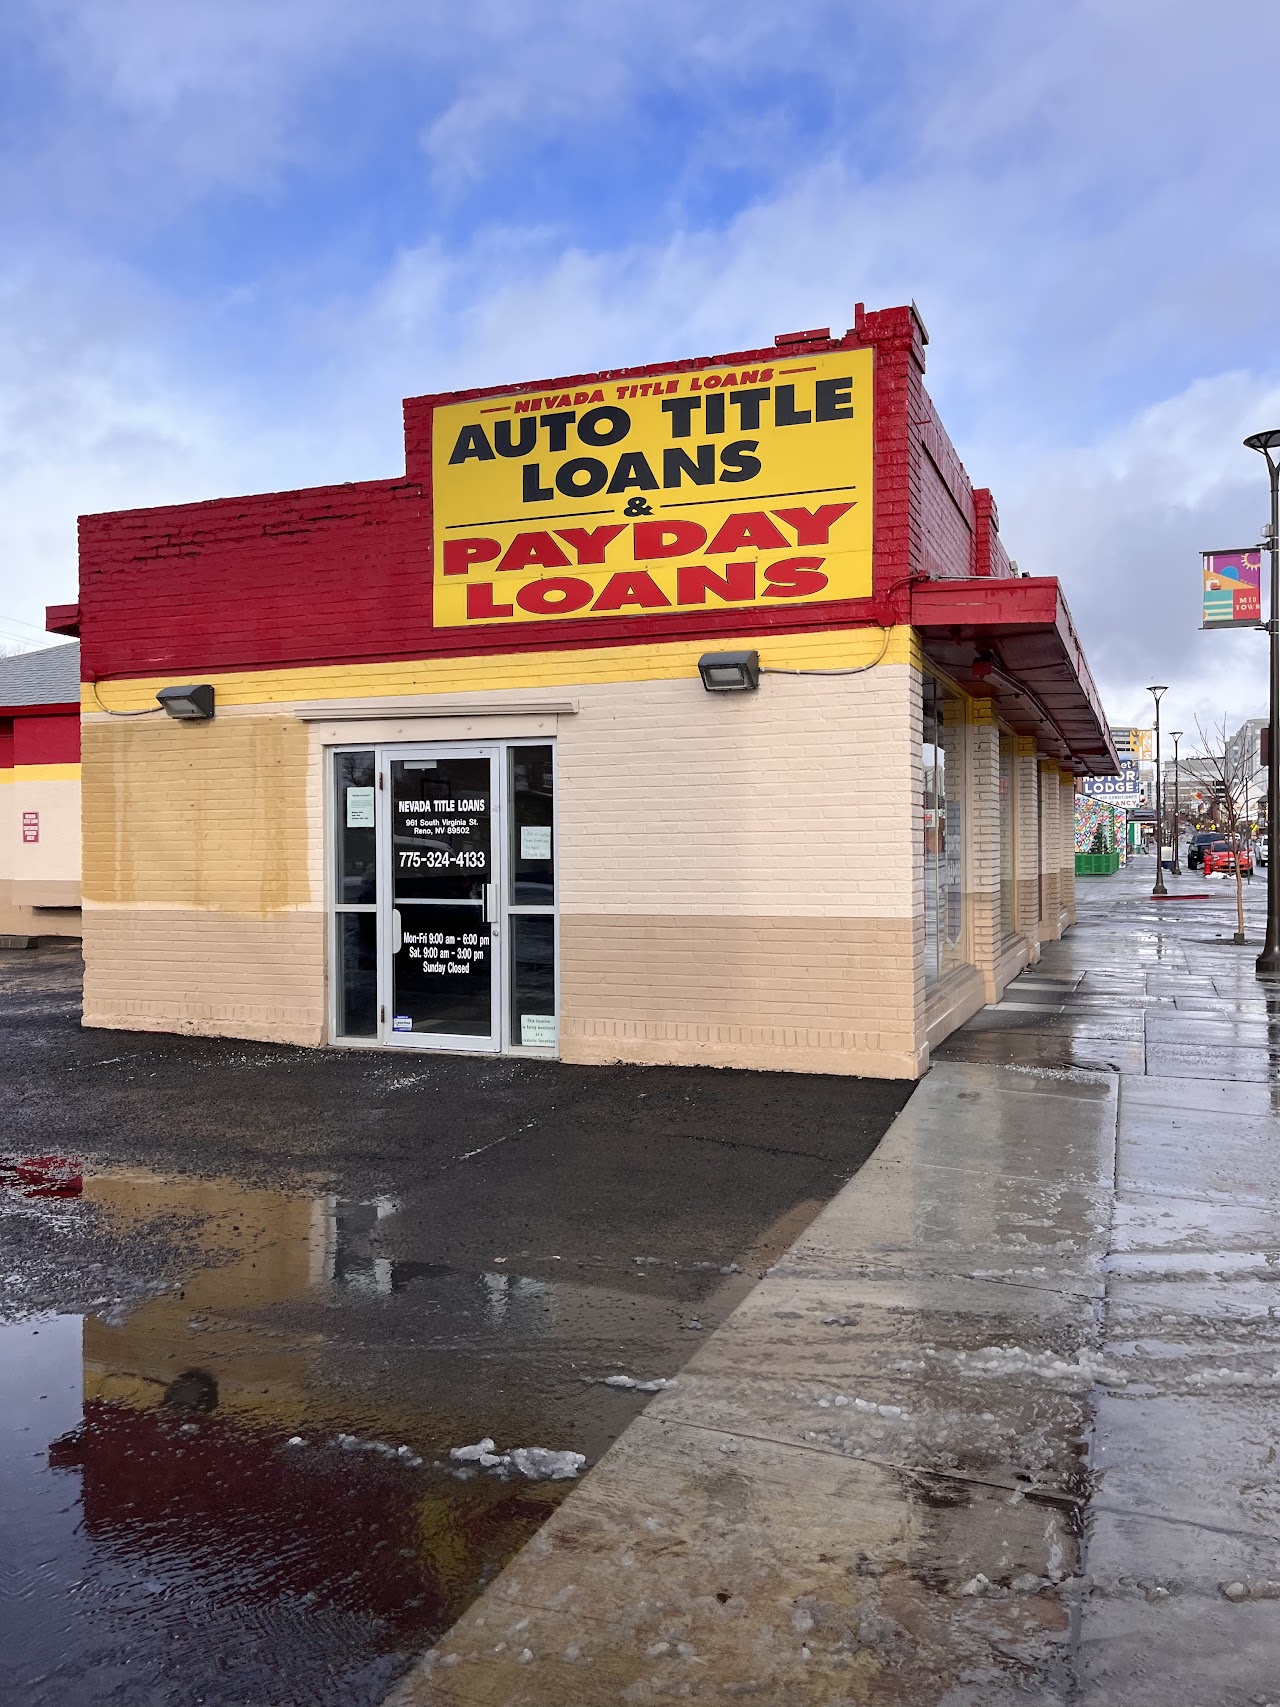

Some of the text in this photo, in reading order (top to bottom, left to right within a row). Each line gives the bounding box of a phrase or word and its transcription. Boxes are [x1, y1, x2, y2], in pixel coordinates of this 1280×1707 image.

[513, 368, 774, 413] NEVADA TITLE LOANS
[448, 376, 854, 465] AUTO TITLE
[522, 440, 762, 503] LOANS
[623, 496, 655, 517] &
[443, 502, 858, 576] PAYDAY
[466, 556, 829, 620] LOANS
[1235, 603, 1260, 611] TOWN
[1239, 596, 1257, 604] MID
[1084, 781, 1134, 794] LODGE
[398, 799, 485, 813] NEVADA TITLE LOANS
[405, 818, 479, 827] 961 South Virginia St.
[413, 827, 433, 835] Reno,
[446, 826, 470, 834] 89502
[399, 851, 485, 868] 775-324-4133
[403, 932, 428, 944] Mon-Fri
[428, 932, 444, 944] 9:00
[445, 935, 455, 944] am
[462, 933, 478, 945] 6:00
[479, 936, 490, 948] pm
[409, 946, 422, 958] Sat.
[423, 947, 438, 958] 9:00
[439, 949, 450, 959] am
[457, 947, 472, 959] 3:00
[473, 950, 484, 962] pm
[422, 960, 470, 976] Sunday Closed
